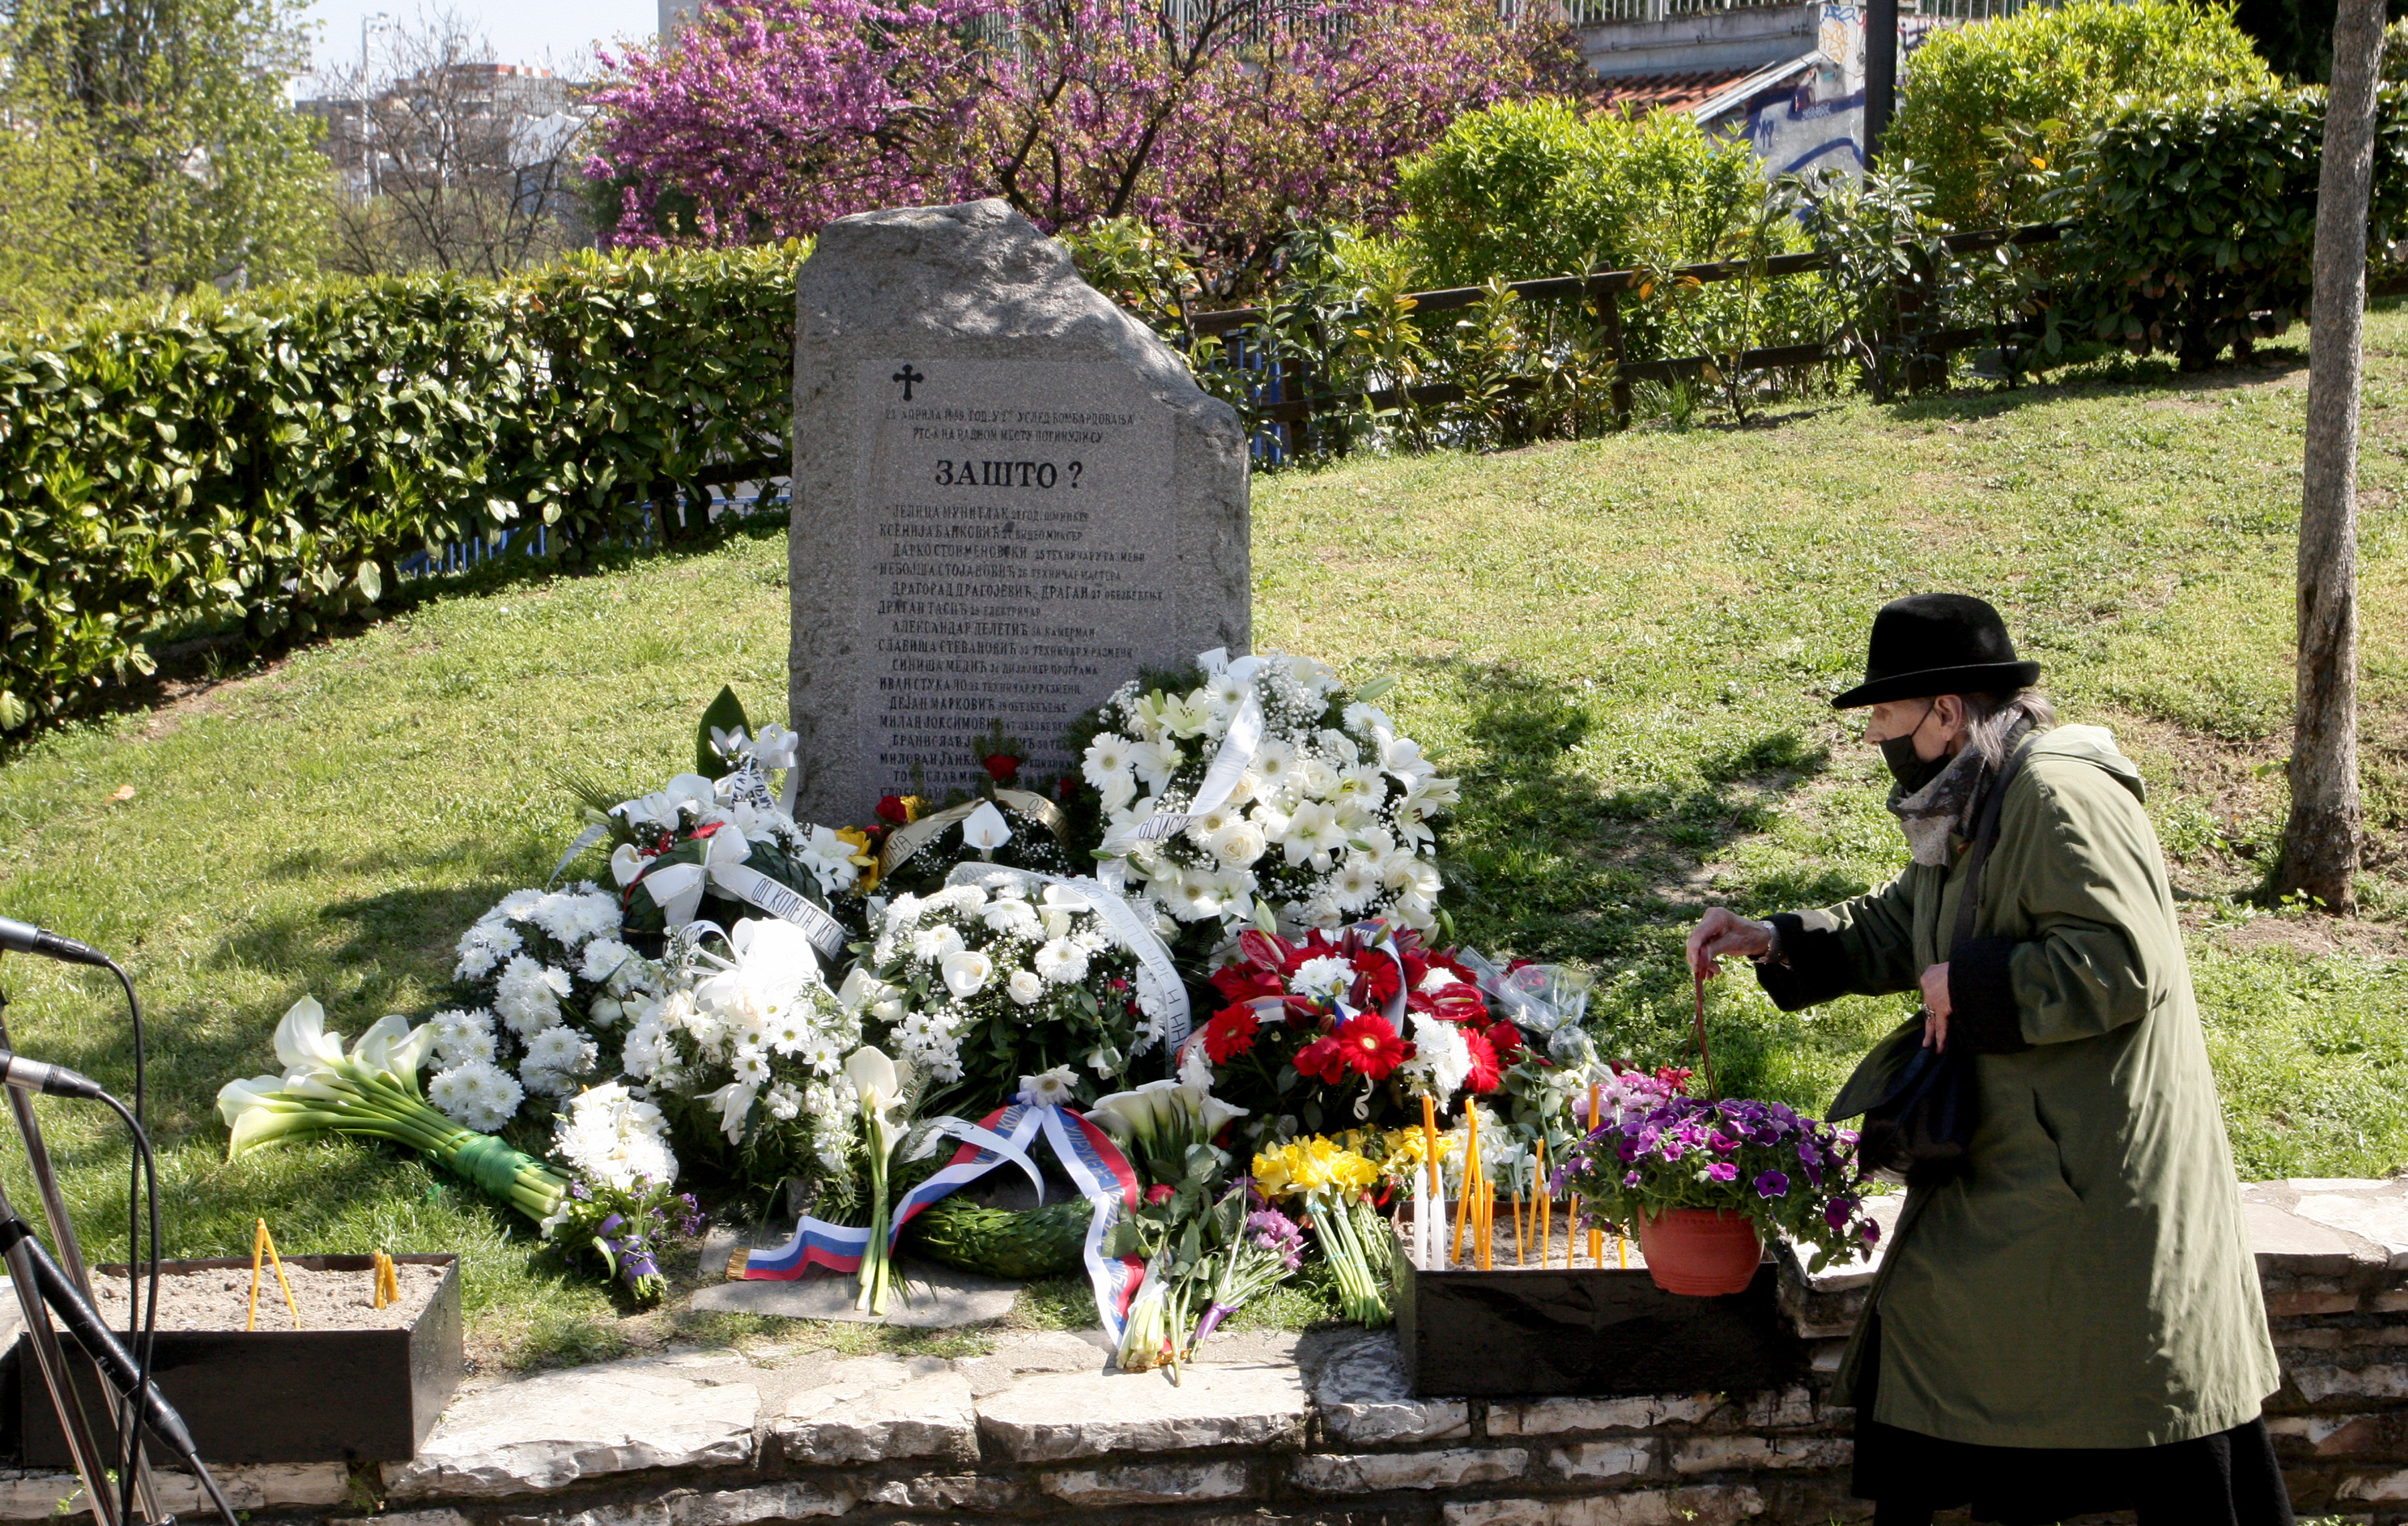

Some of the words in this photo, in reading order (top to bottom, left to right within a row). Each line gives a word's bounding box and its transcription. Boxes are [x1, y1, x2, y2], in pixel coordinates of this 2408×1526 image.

[1017, 411, 1050, 425] УСЛЕД
[1052, 412, 1134, 426] БОМБАРДОВАЊА
[913, 427, 939, 440] РТС-А
[941, 428, 956, 441] НА
[957, 428, 997, 442] РАДНОМ
[1000, 429, 1033, 443] МЕСТУ
[1090, 431, 1104, 444] СУ
[935, 459, 1058, 489] ЗАШТО
[1068, 461, 1083, 488] ?
[892, 505, 940, 520] ЈЕЛИЦА
[942, 505, 1009, 521] МУНИТЛАК
[880, 524, 933, 538] КСЕНИЈА
[934, 524, 999, 539] БАНКОВИЋ
[892, 543, 932, 558] ДАРКО
[933, 543, 1028, 559] СТОИМЕНОВСКИ
[878, 562, 936, 576] НЕБОЈША
[937, 562, 1016, 578] СТОЈАНОВИЋ
[892, 582, 954, 597] ДРАГОРАД
[1041, 585, 1089, 601] ДРАГАН
[878, 601, 925, 615] ДРАГАН
[927, 601, 968, 616] ТАСИЋ
[892, 621, 971, 635] АЛЕКСАНДАР
[974, 622, 1028, 637] ДЕЛЕТИЋ
[878, 639, 936, 653] СЛАВИША
[939, 640, 1017, 655] СТЕВАНОВИЋ
[892, 659, 943, 672] СИНИША
[946, 659, 988, 674] МЕДИЋ
[879, 677, 911, 691] ИВАН
[913, 677, 968, 692] СТУКАЛО
[889, 696, 927, 711] ДЕЈАН
[930, 697, 995, 712] МАРКОВИЋ
[879, 715, 922, 730] МИЛАН
[892, 734, 963, 748] БРАНИСЛАВ
[938, 754, 979, 767] ЈАНКО
[751, 878, 773, 905] ОД
[769, 887, 819, 930] КОЛЕГА
[813, 918, 836, 946] ИЗ
